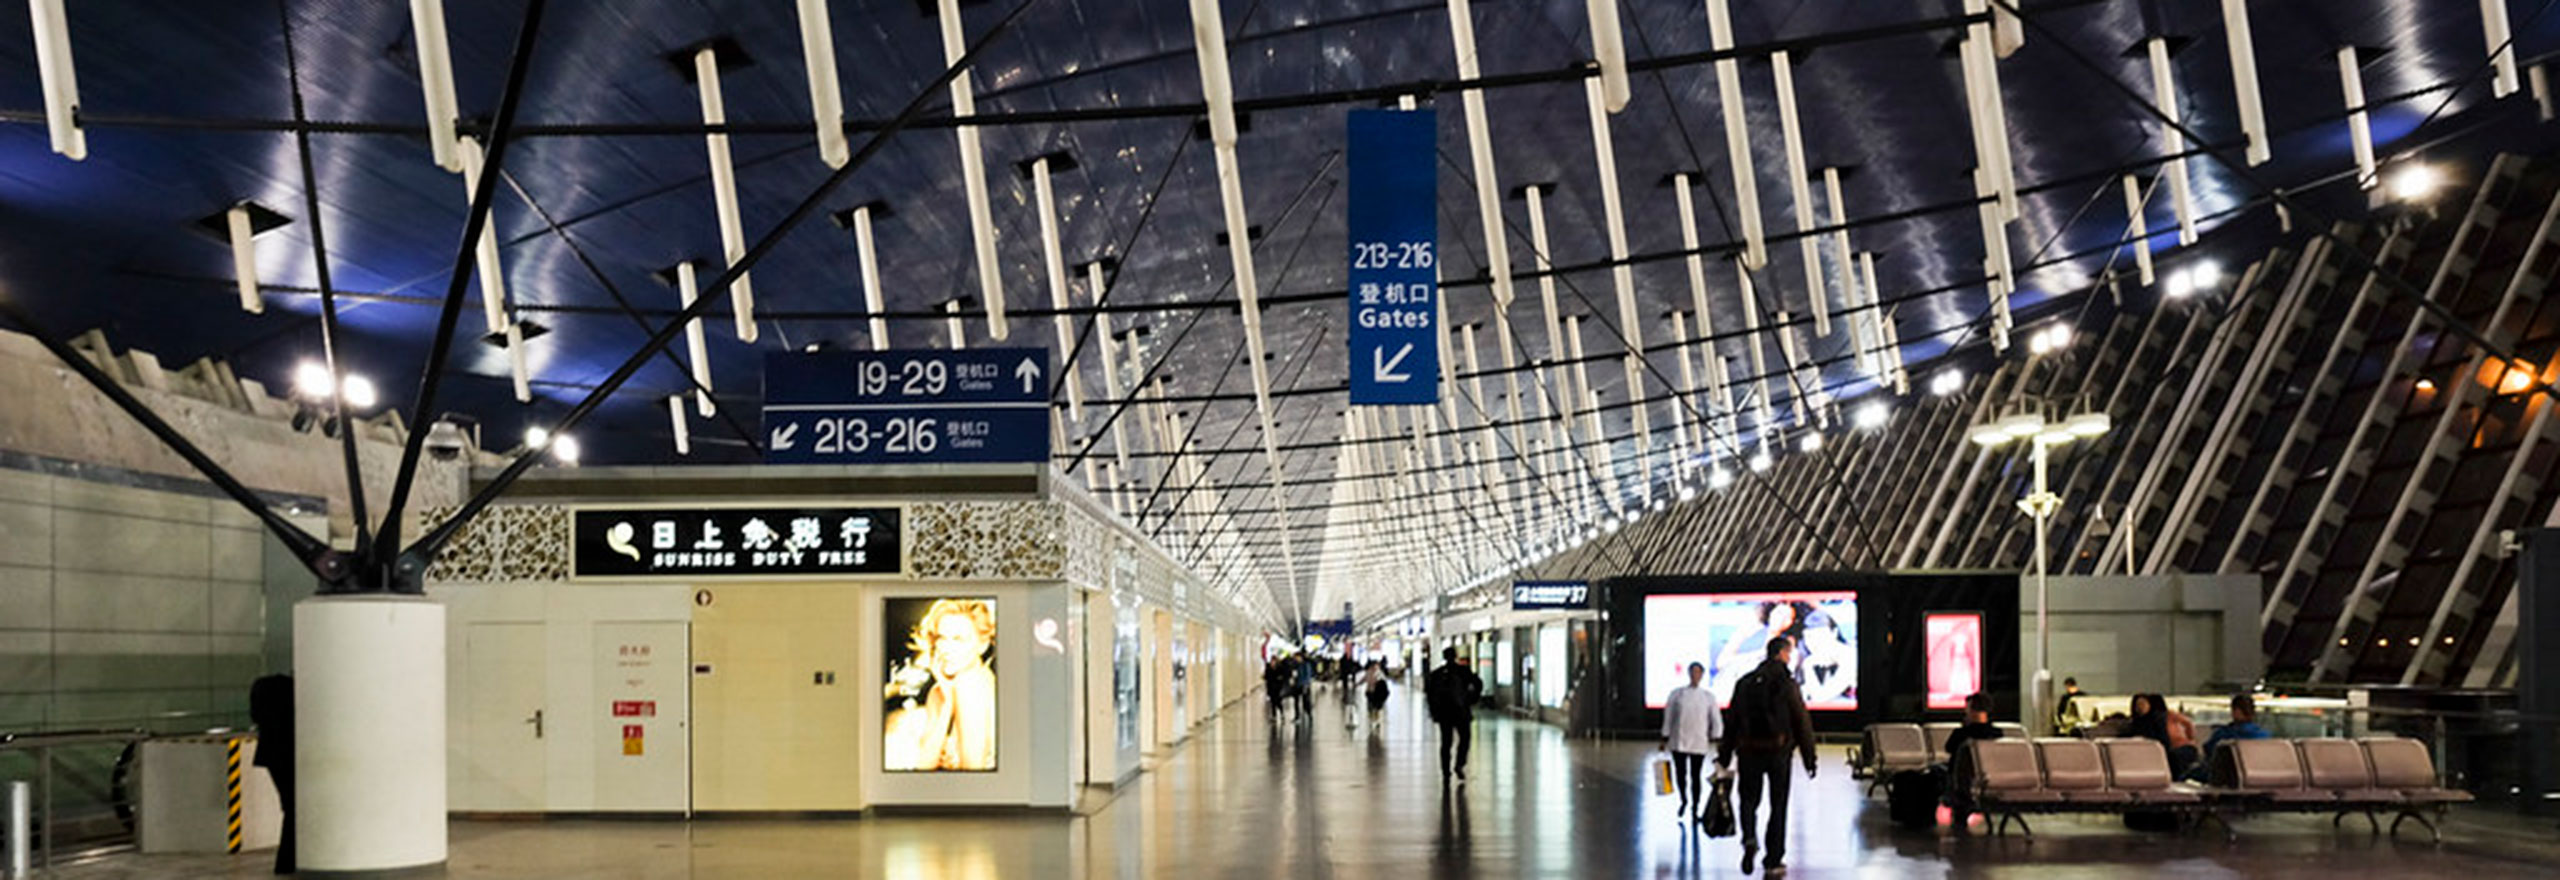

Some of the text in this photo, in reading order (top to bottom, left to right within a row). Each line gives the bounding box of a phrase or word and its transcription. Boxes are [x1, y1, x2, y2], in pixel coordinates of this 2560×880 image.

[1353, 242, 1434, 269] 213-216
[1359, 282, 1430, 304] 登机口
[1358, 307, 1429, 328] Gates
[858, 360, 947, 396] 19-29
[956, 363, 998, 378] 登机口
[959, 379, 993, 391] Gates
[814, 417, 937, 453] 213-216
[947, 421, 989, 436] 登机口
[950, 436, 984, 448] Gates
[652, 517, 871, 549] 日上免税行
[652, 551, 867, 567] SUNRISE DUTY FREE
